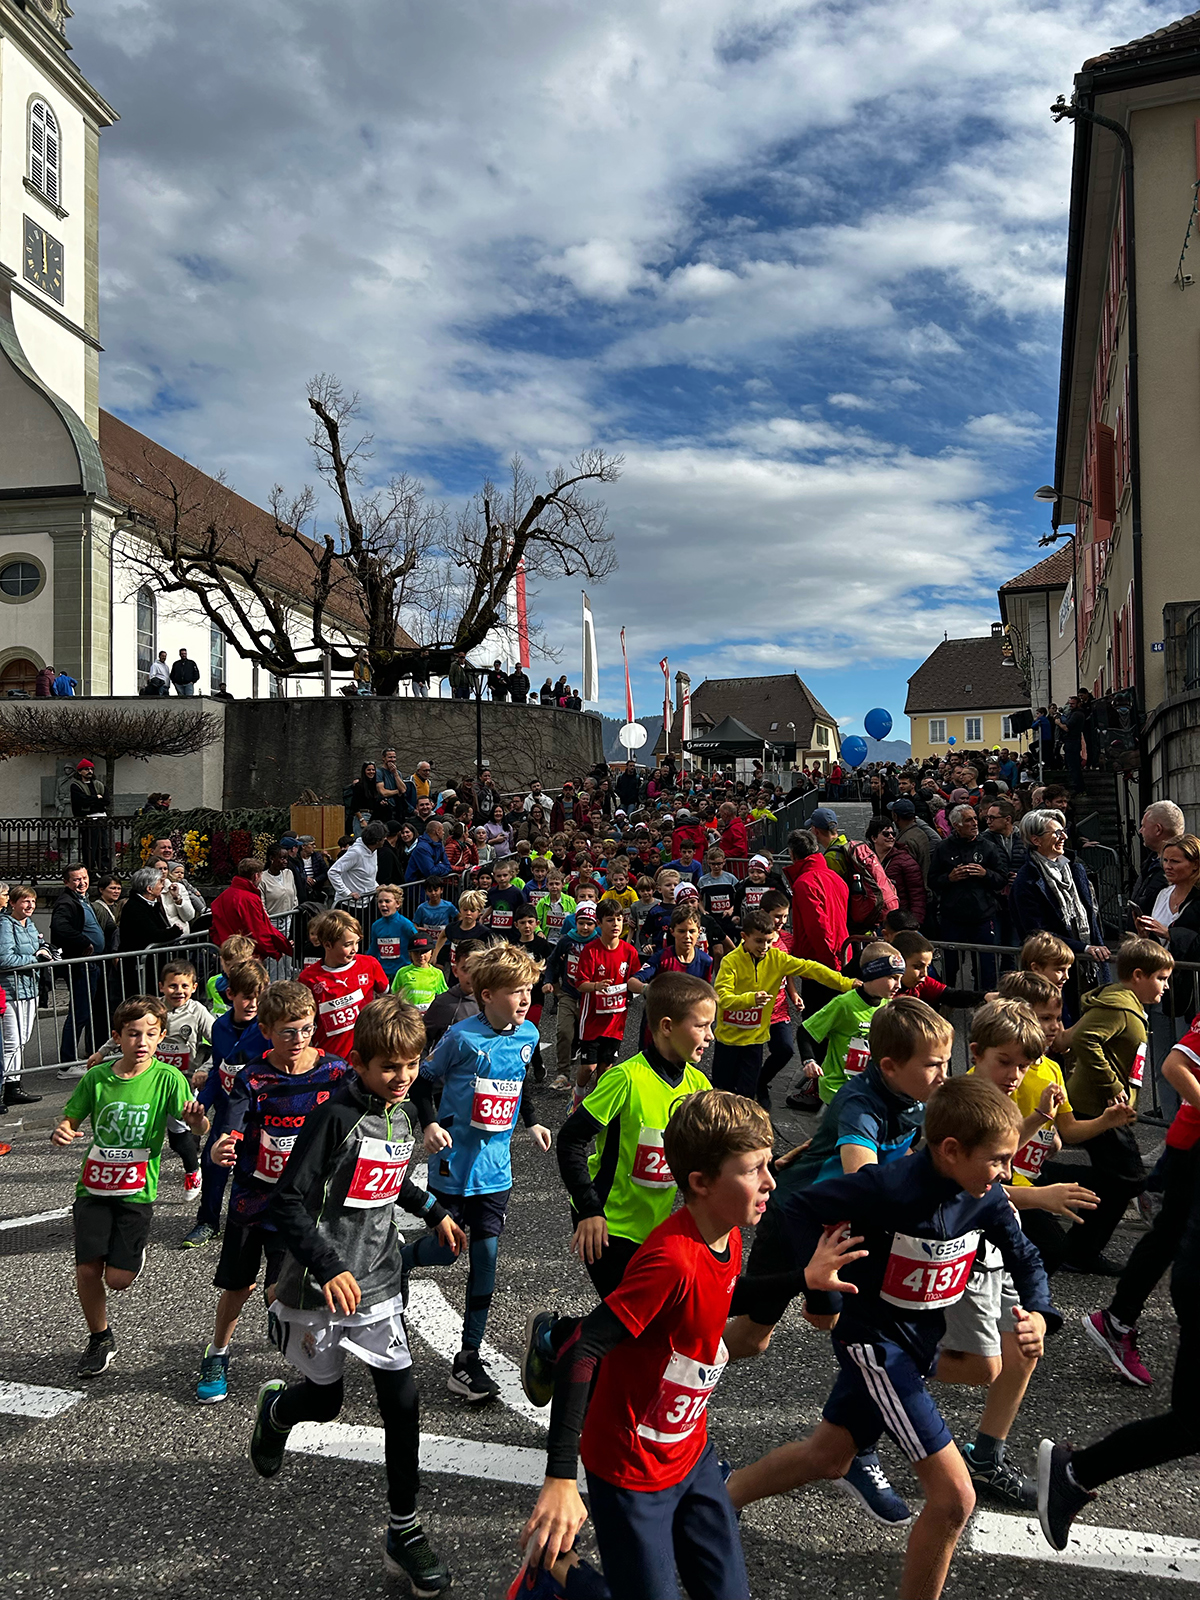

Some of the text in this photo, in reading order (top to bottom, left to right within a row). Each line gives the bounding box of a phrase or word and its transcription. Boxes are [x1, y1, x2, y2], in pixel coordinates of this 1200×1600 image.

[712, 901, 730, 909] 4330
[380, 946, 394, 954] 452
[335, 995, 354, 1006] GESA
[602, 994, 624, 1007] 1519
[329, 1005, 360, 1026] 1331
[728, 1011, 758, 1022] 2020
[160, 1043, 179, 1051] GESA
[499, 1082, 518, 1092] GESA
[107, 1150, 134, 1159] GESA
[1023, 1144, 1048, 1166] 13
[264, 1152, 290, 1172] 13
[89, 1164, 138, 1185] 3573
[364, 1163, 408, 1192] 2710
[935, 1239, 966, 1256] GESA
[902, 1260, 967, 1293] 4137
